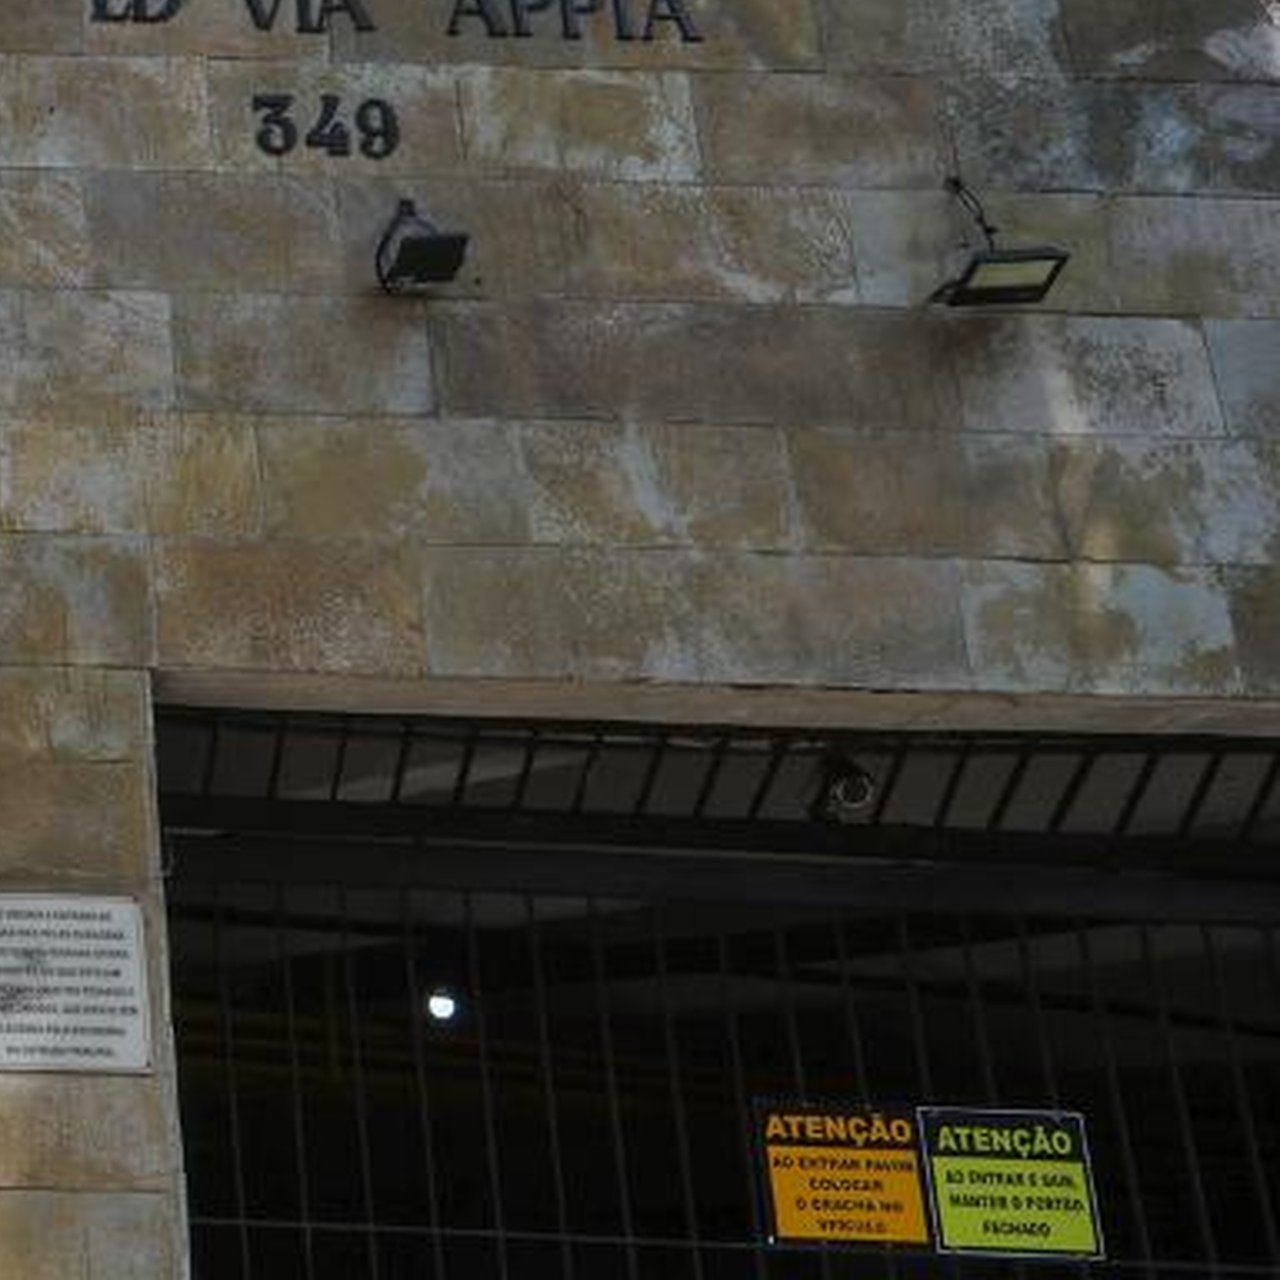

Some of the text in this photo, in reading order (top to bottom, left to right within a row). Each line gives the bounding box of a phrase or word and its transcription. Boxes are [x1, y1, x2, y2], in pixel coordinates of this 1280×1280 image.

[252, 94, 400, 160] 349
[767, 1114, 911, 1146] ATENÇÃO
[938, 1126, 1071, 1158] ATENÇÃO
